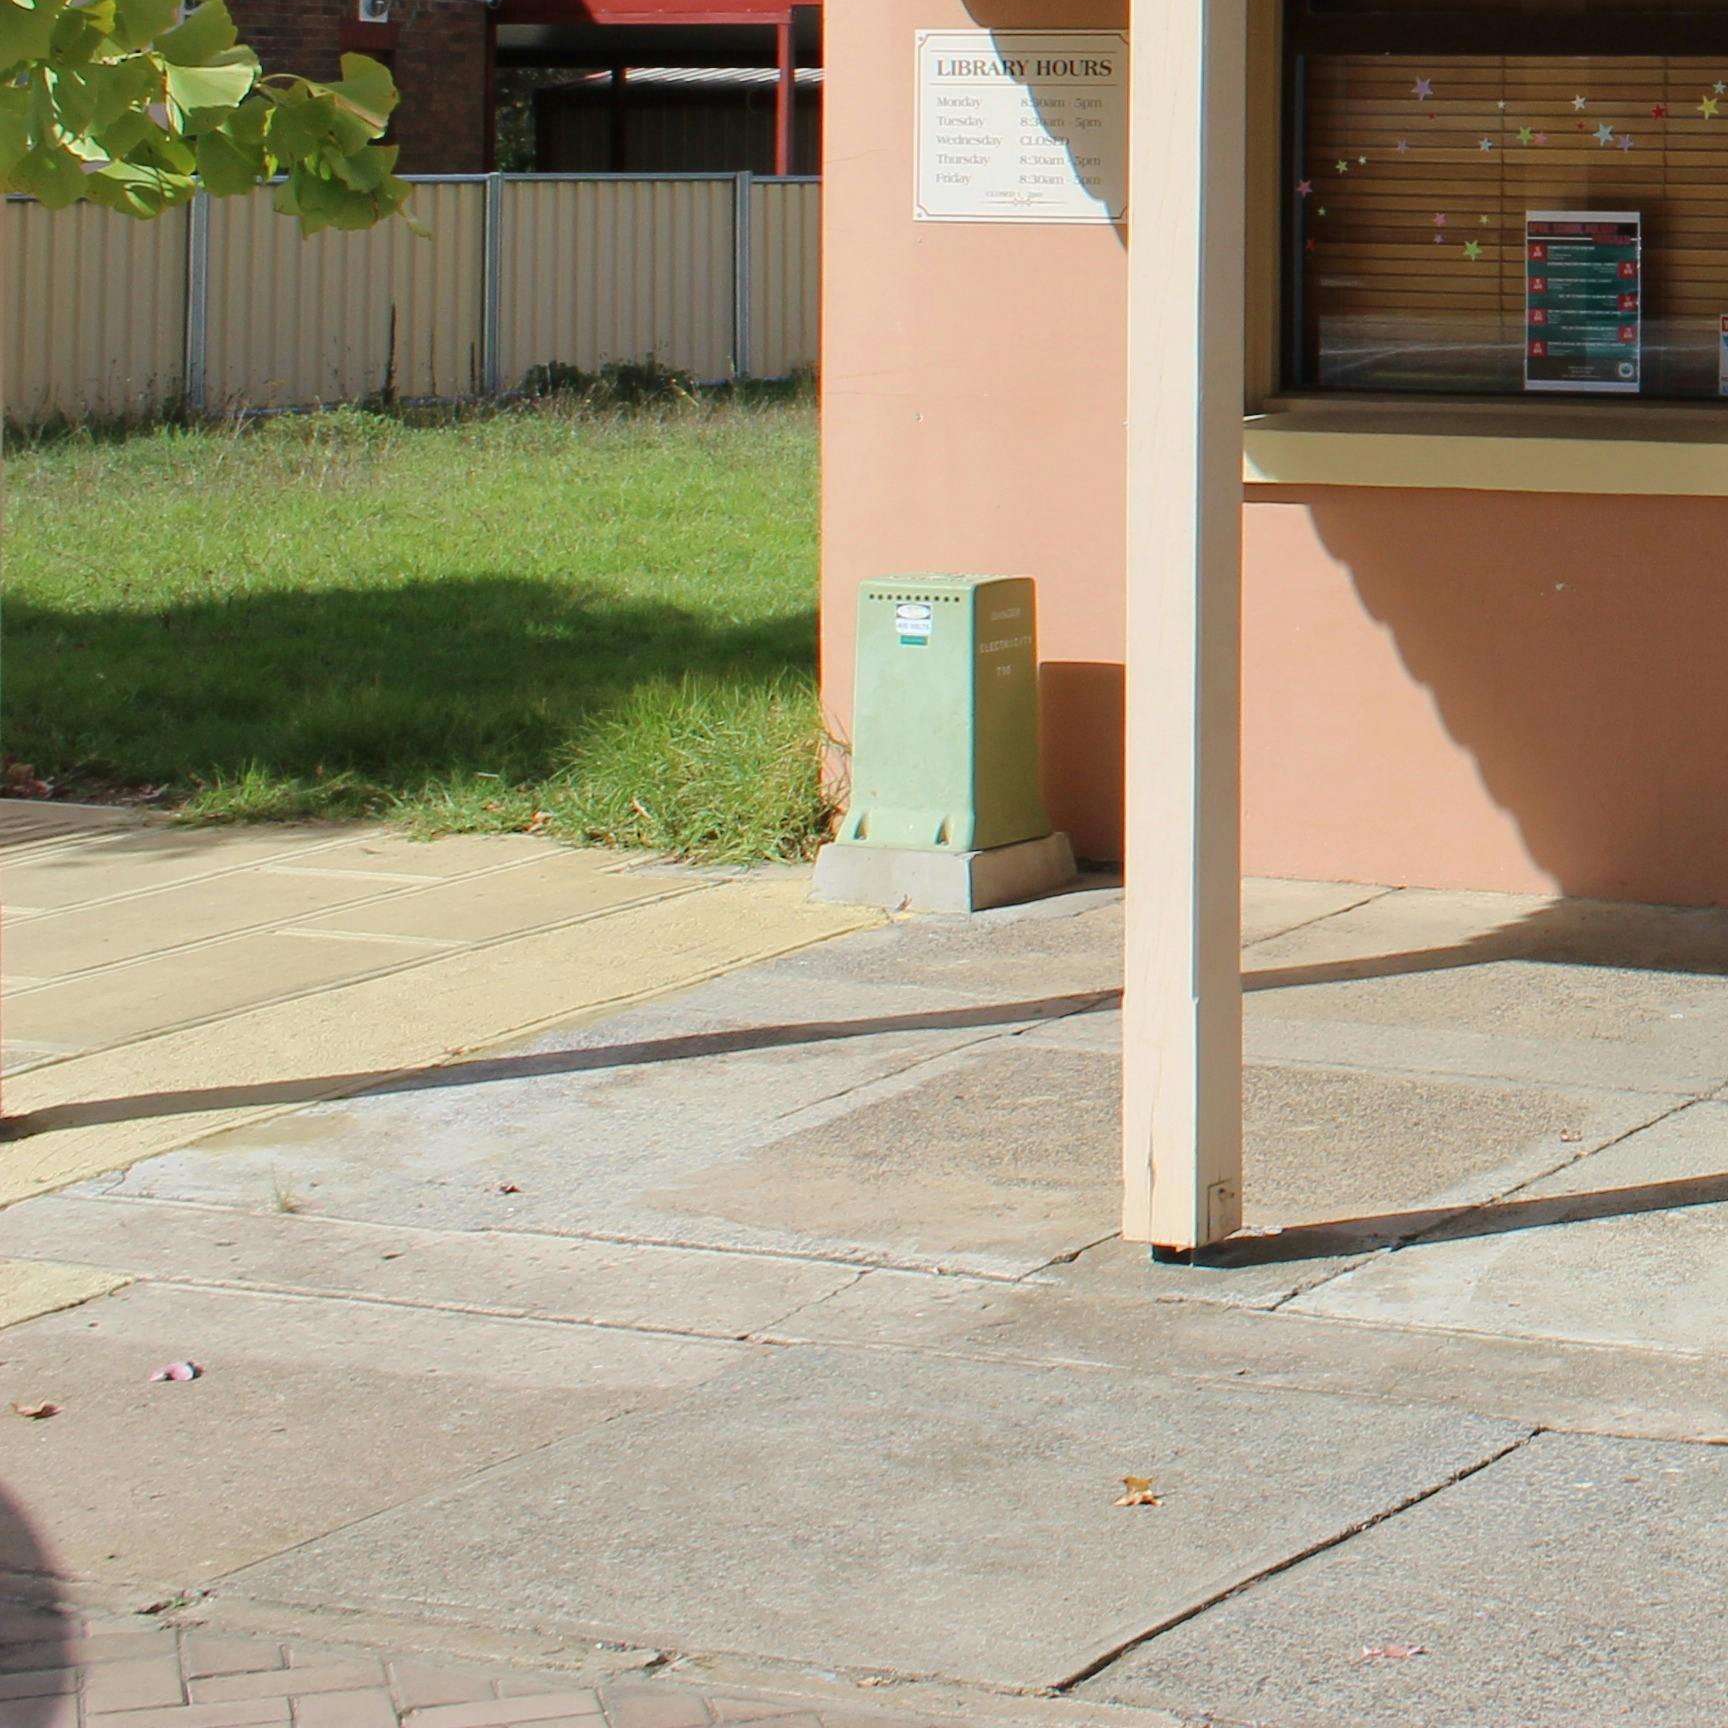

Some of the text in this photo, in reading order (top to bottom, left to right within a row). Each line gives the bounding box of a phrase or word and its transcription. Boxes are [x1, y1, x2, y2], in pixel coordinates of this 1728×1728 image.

[937, 59, 1112, 76] LIBRARY HOURS
[936, 97, 982, 110] Monday
[937, 116, 984, 129] Tuesday
[936, 135, 1069, 148] Wednesday CLOSED
[937, 154, 991, 166] Thursday
[936, 174, 972, 186] Friday
